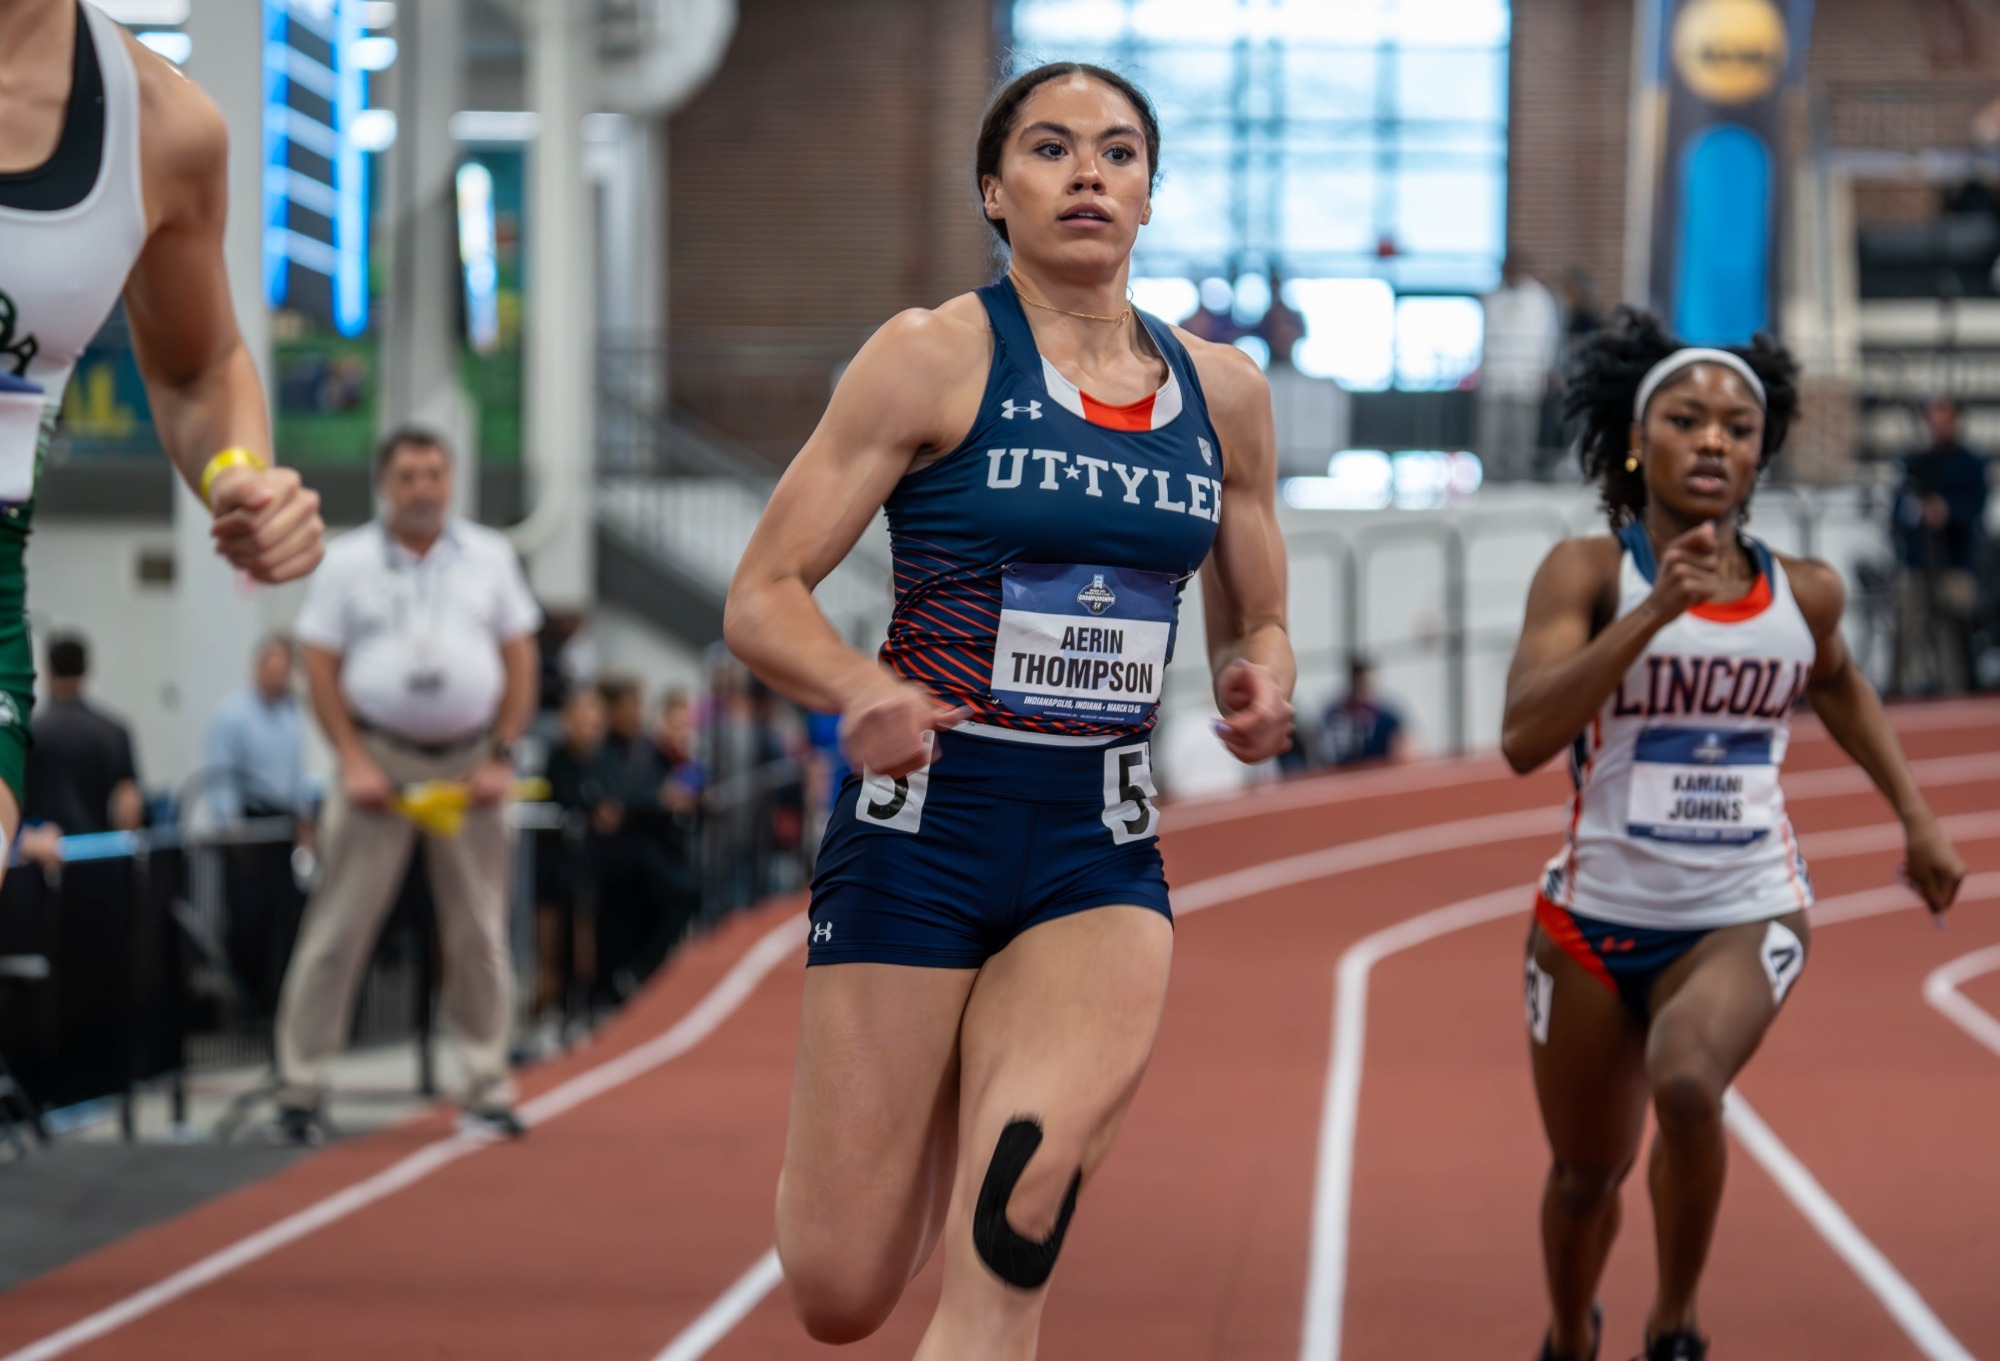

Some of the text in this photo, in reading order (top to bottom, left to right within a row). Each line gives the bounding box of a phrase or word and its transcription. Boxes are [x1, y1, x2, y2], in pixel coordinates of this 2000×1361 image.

[986, 448, 1067, 491] UT
[1060, 626, 1124, 654] AERIN
[1011, 652, 1153, 694] THOMPSON
[1023, 695, 1073, 710] INDIANAPOLIS,
[1074, 700, 1102, 711] INDIANA
[1106, 702, 1128, 713] MARCH
[1118, 750, 1151, 835] 5
[1673, 774, 1743, 793] KAMANI
[1668, 797, 1743, 822] JOHNS
